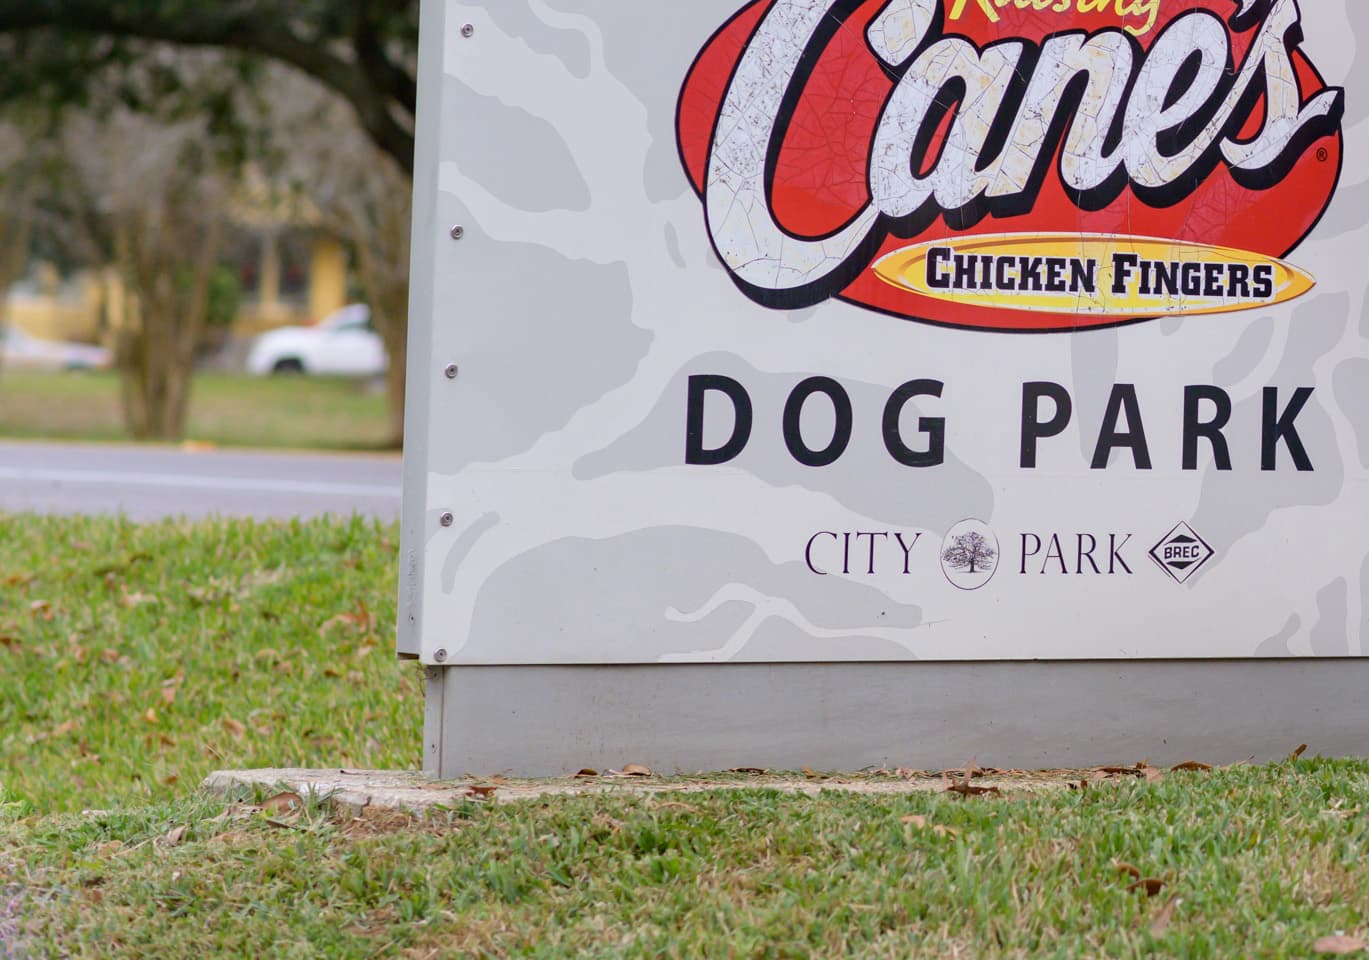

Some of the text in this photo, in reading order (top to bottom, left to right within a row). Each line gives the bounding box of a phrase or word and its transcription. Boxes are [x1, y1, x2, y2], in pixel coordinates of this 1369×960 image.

[925, 246, 1273, 299] CHICKEN FINGERS
[684, 373, 1315, 472] DOG PARK
[804, 529, 1134, 576] CITY PARK
[1163, 544, 1200, 560] BREC
